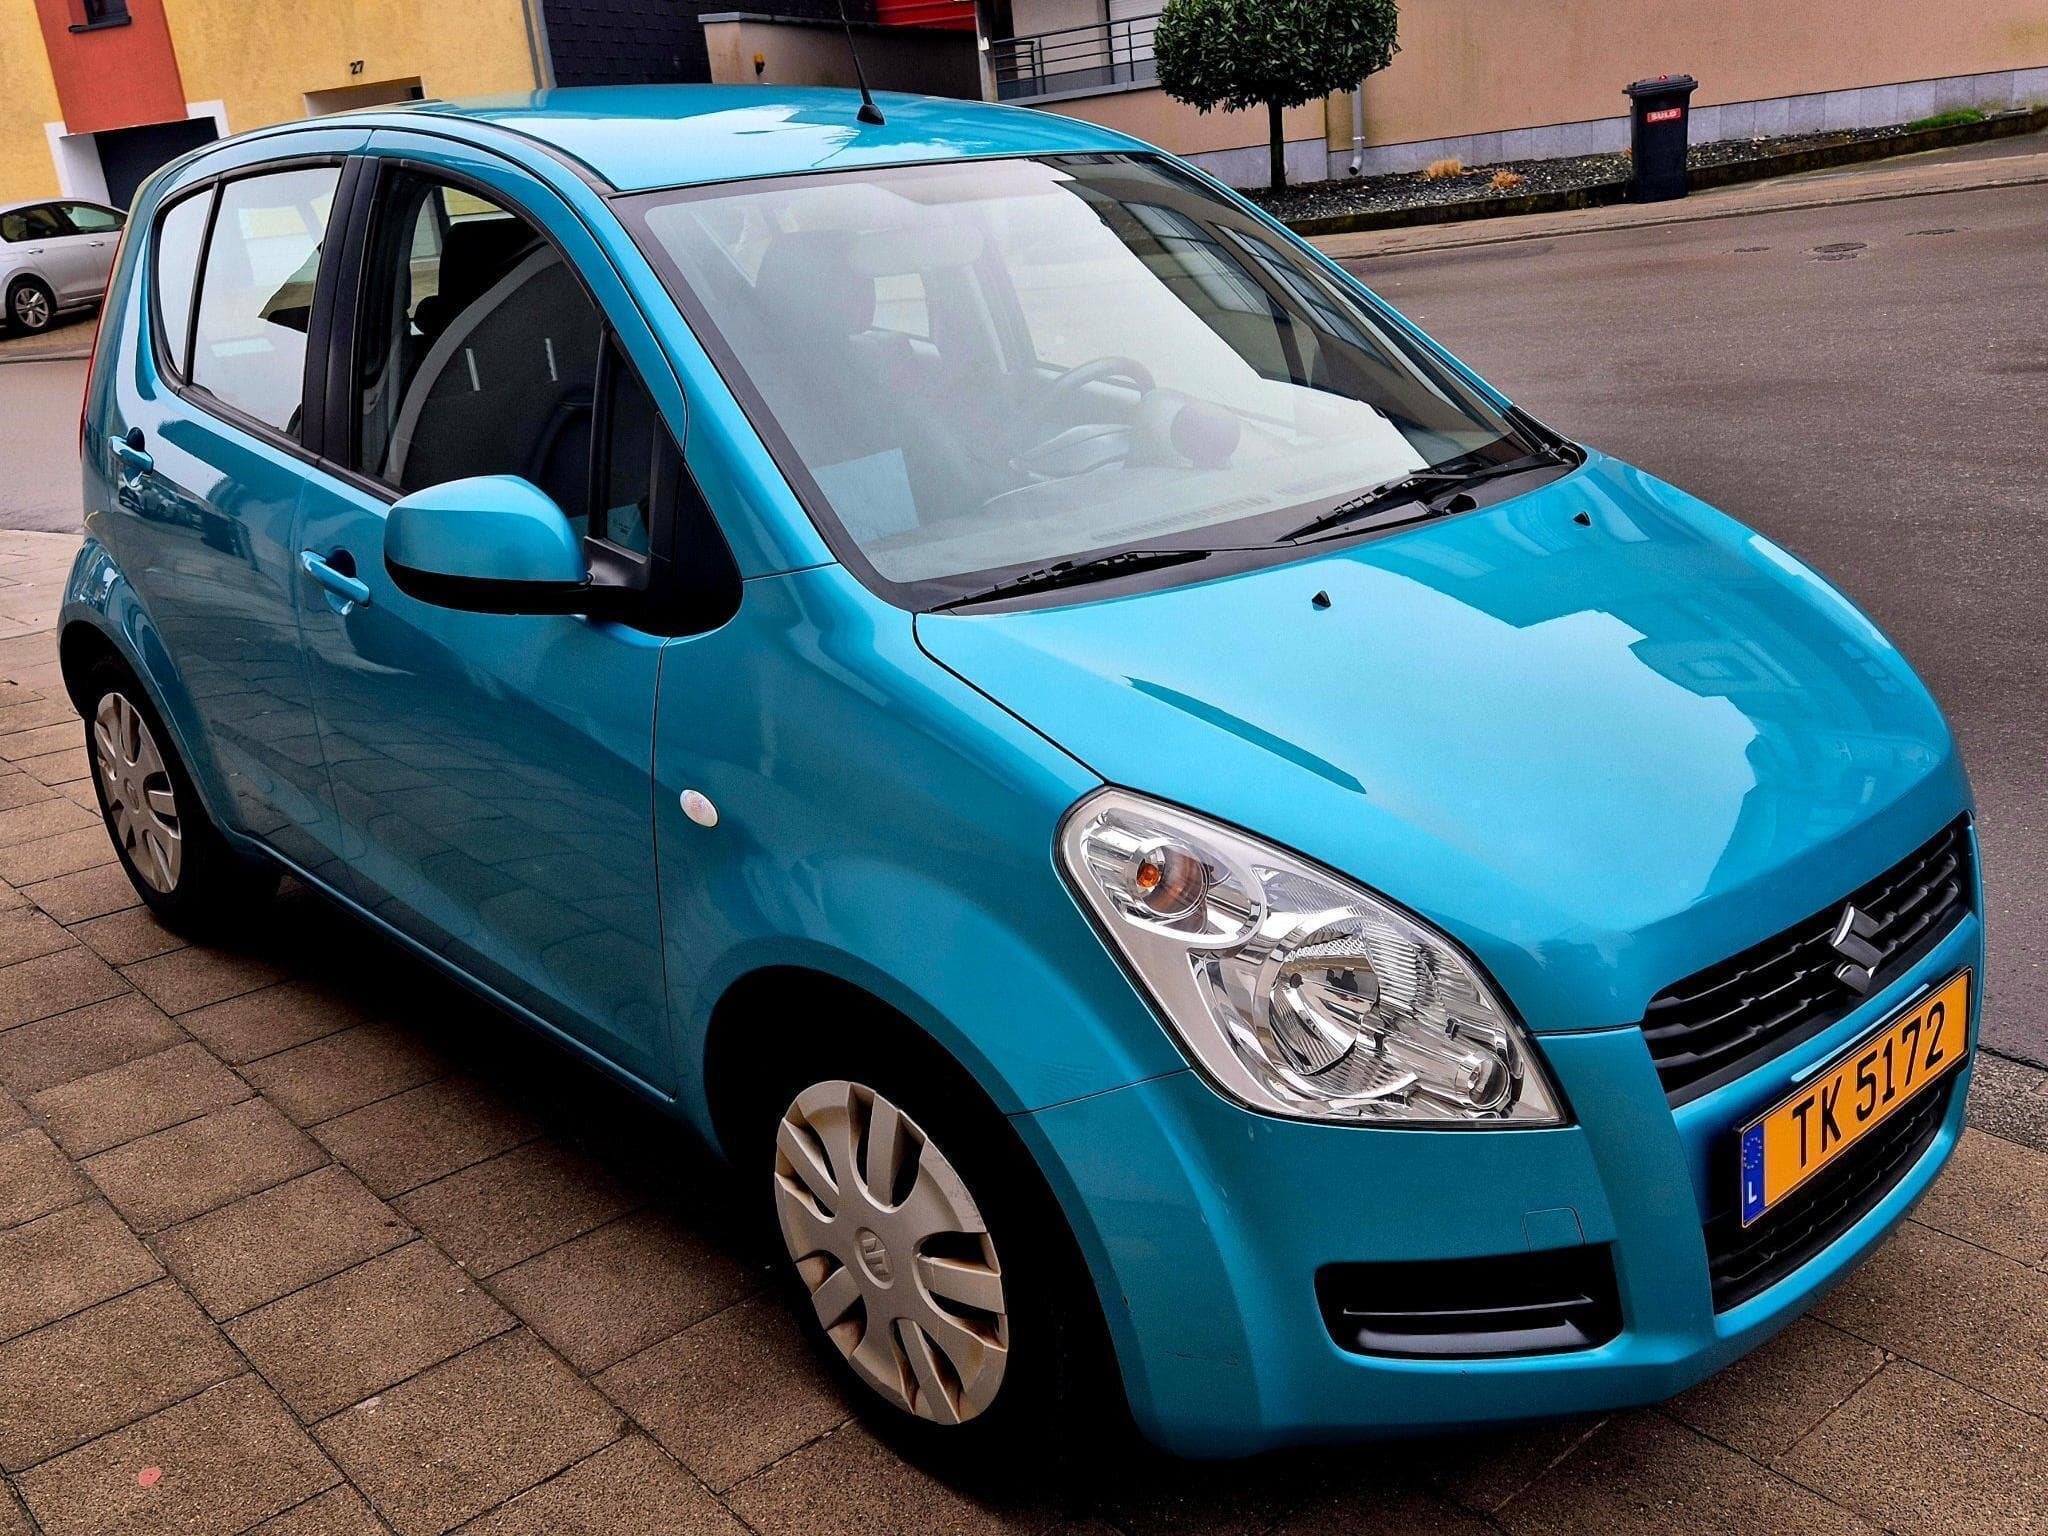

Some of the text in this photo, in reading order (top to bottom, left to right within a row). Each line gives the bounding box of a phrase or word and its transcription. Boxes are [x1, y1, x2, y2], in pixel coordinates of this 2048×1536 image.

[349, 60, 365, 75] 27
[1651, 109, 1678, 121] SULO
[1792, 1001, 1946, 1169] TK 5172
[1747, 1181, 1758, 1204] L
